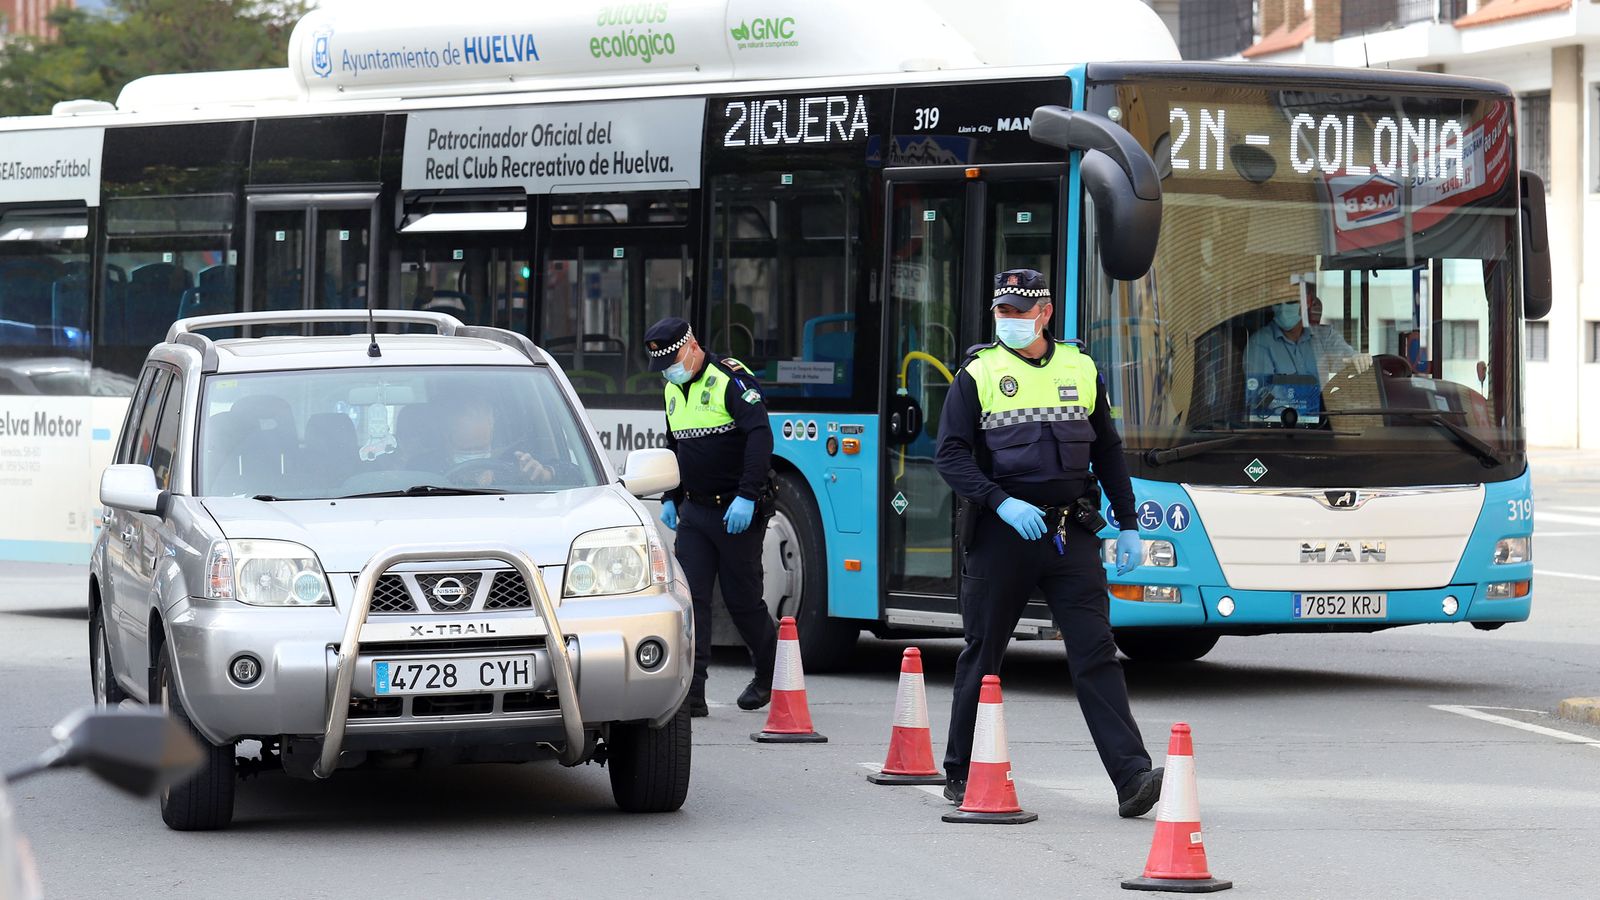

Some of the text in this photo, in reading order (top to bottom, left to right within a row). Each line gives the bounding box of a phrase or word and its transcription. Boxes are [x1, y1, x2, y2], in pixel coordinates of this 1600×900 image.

[752, 17, 795, 39] GNC
[342, 34, 540, 76] Ayuntamiento de HUELVA
[589, 28, 676, 63] ecológico
[914, 107, 940, 131] 319
[978, 125, 993, 134] City
[428, 121, 612, 151] Patrocinador Oficial del
[1169, 108, 1226, 171] 2N
[1290, 113, 1464, 179] COLONIA
[0, 158, 91, 181] EATsomosFútbol
[426, 150, 675, 180] Real Club Recreativo de Huelva.
[34, 411, 82, 437] Motor
[616, 423, 667, 451] Moto
[1249, 466, 1263, 474] CNG
[1507, 499, 1533, 522] 319
[1300, 541, 1387, 563] MAN
[1306, 596, 1346, 615] 7852
[1352, 596, 1381, 615] KRJ
[410, 623, 497, 636] X-TRAIL
[391, 663, 459, 690] 4728
[480, 661, 529, 687] CYH
